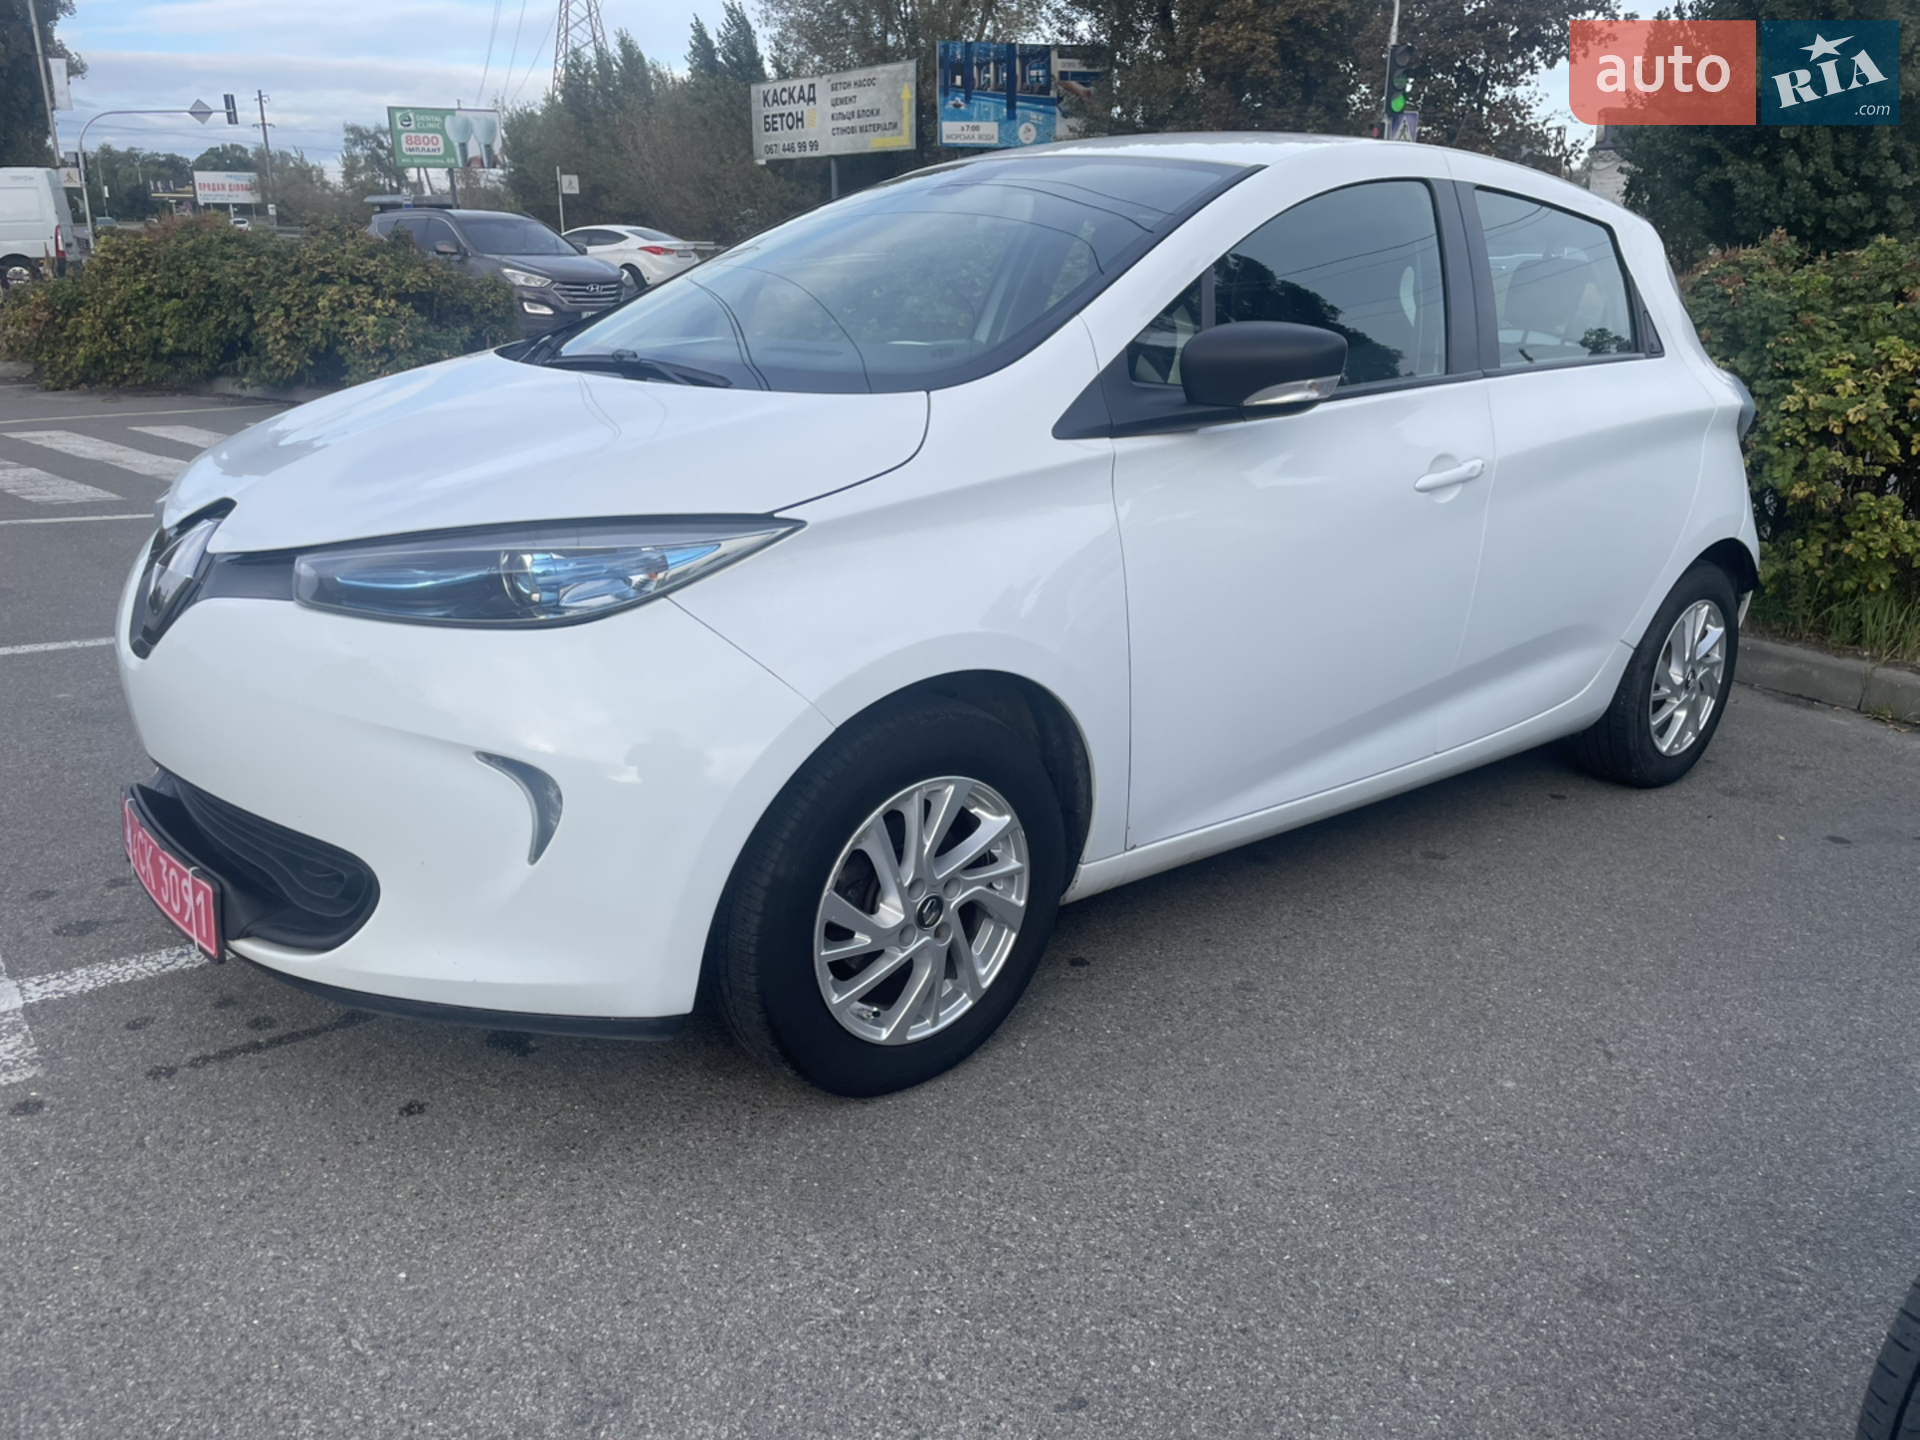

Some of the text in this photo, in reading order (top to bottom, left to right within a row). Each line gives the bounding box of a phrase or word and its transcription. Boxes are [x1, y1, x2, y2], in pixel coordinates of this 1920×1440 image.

[830, 77, 876, 92] БЕТОН НАСОС
[762, 83, 817, 108] КАСКАД
[830, 95, 857, 107] ЦЕМЕНТ
[416, 114, 442, 122] DENTAL
[857, 108, 880, 119] БЛОКИ
[763, 110, 804, 132] БЕТОН
[859, 121, 898, 133] МАТЕРІАЛИ
[965, 124, 980, 132] 7:00
[405, 135, 439, 146] 8800
[782, 142, 796, 153] 446
[797, 141, 807, 153] 99
[809, 139, 819, 152] 99
[158, 856, 206, 938] 3091
